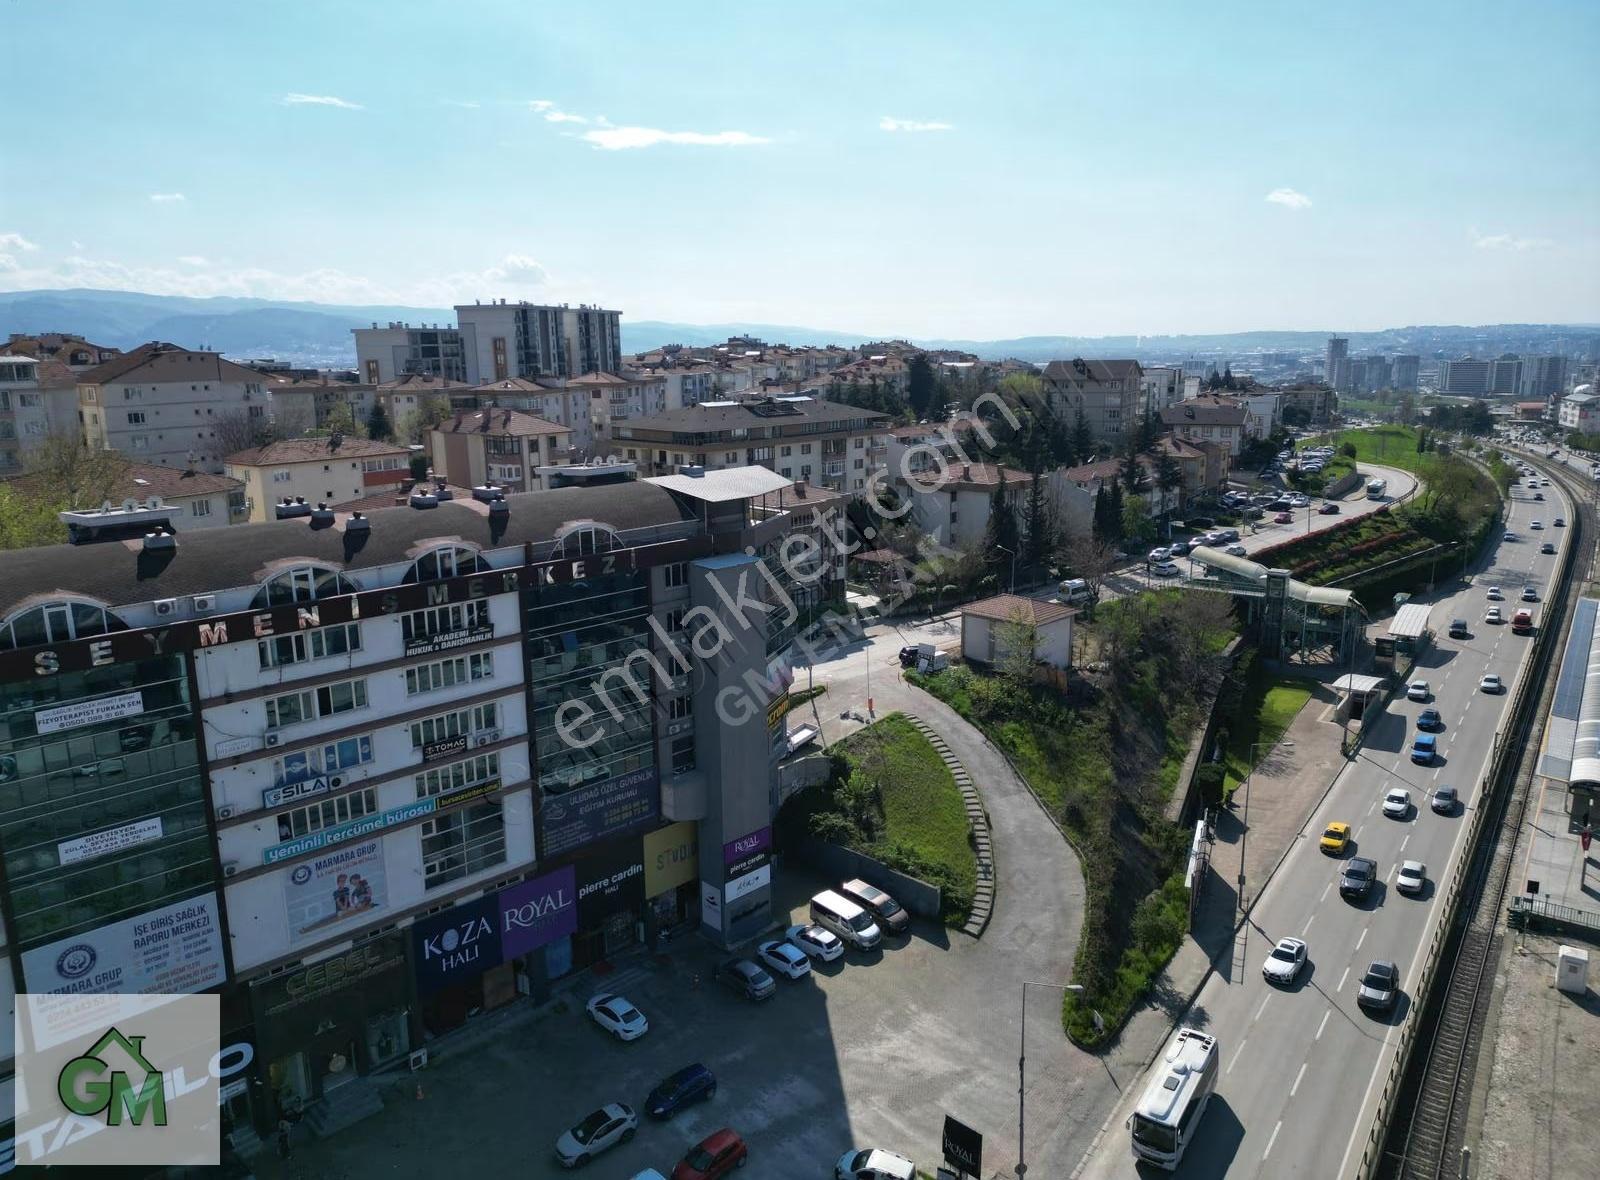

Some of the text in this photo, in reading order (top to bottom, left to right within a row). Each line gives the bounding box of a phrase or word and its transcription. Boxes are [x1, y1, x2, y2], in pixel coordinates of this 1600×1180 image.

[34, 605, 322, 676] SEYMEN
[406, 644, 433, 657] HUKUK
[441, 632, 493, 649] DANIŞMANLIK
[96, 703, 126, 714] FURKAN
[282, 779, 326, 799] SILA
[606, 788, 638, 806] KURUMU
[268, 802, 433, 863] yeminli tercüme bürosu
[734, 834, 760, 853] ROYAL
[314, 850, 356, 871] MARMARA
[357, 843, 377, 857] GRUP
[729, 861, 747, 874] pierre
[747, 853, 765, 866] cardin
[578, 863, 643, 899] pierre cardin
[604, 885, 619, 895] HALI
[175, 904, 207, 922] SAĞLIK
[504, 888, 573, 932] ROYAL
[134, 929, 170, 950] RAPORU
[172, 915, 210, 938] MERKEZİ
[424, 916, 493, 960] KOZA
[441, 944, 479, 972] HALI
[95, 967, 122, 985] GRUP
[0, 1112, 107, 1175] TA
